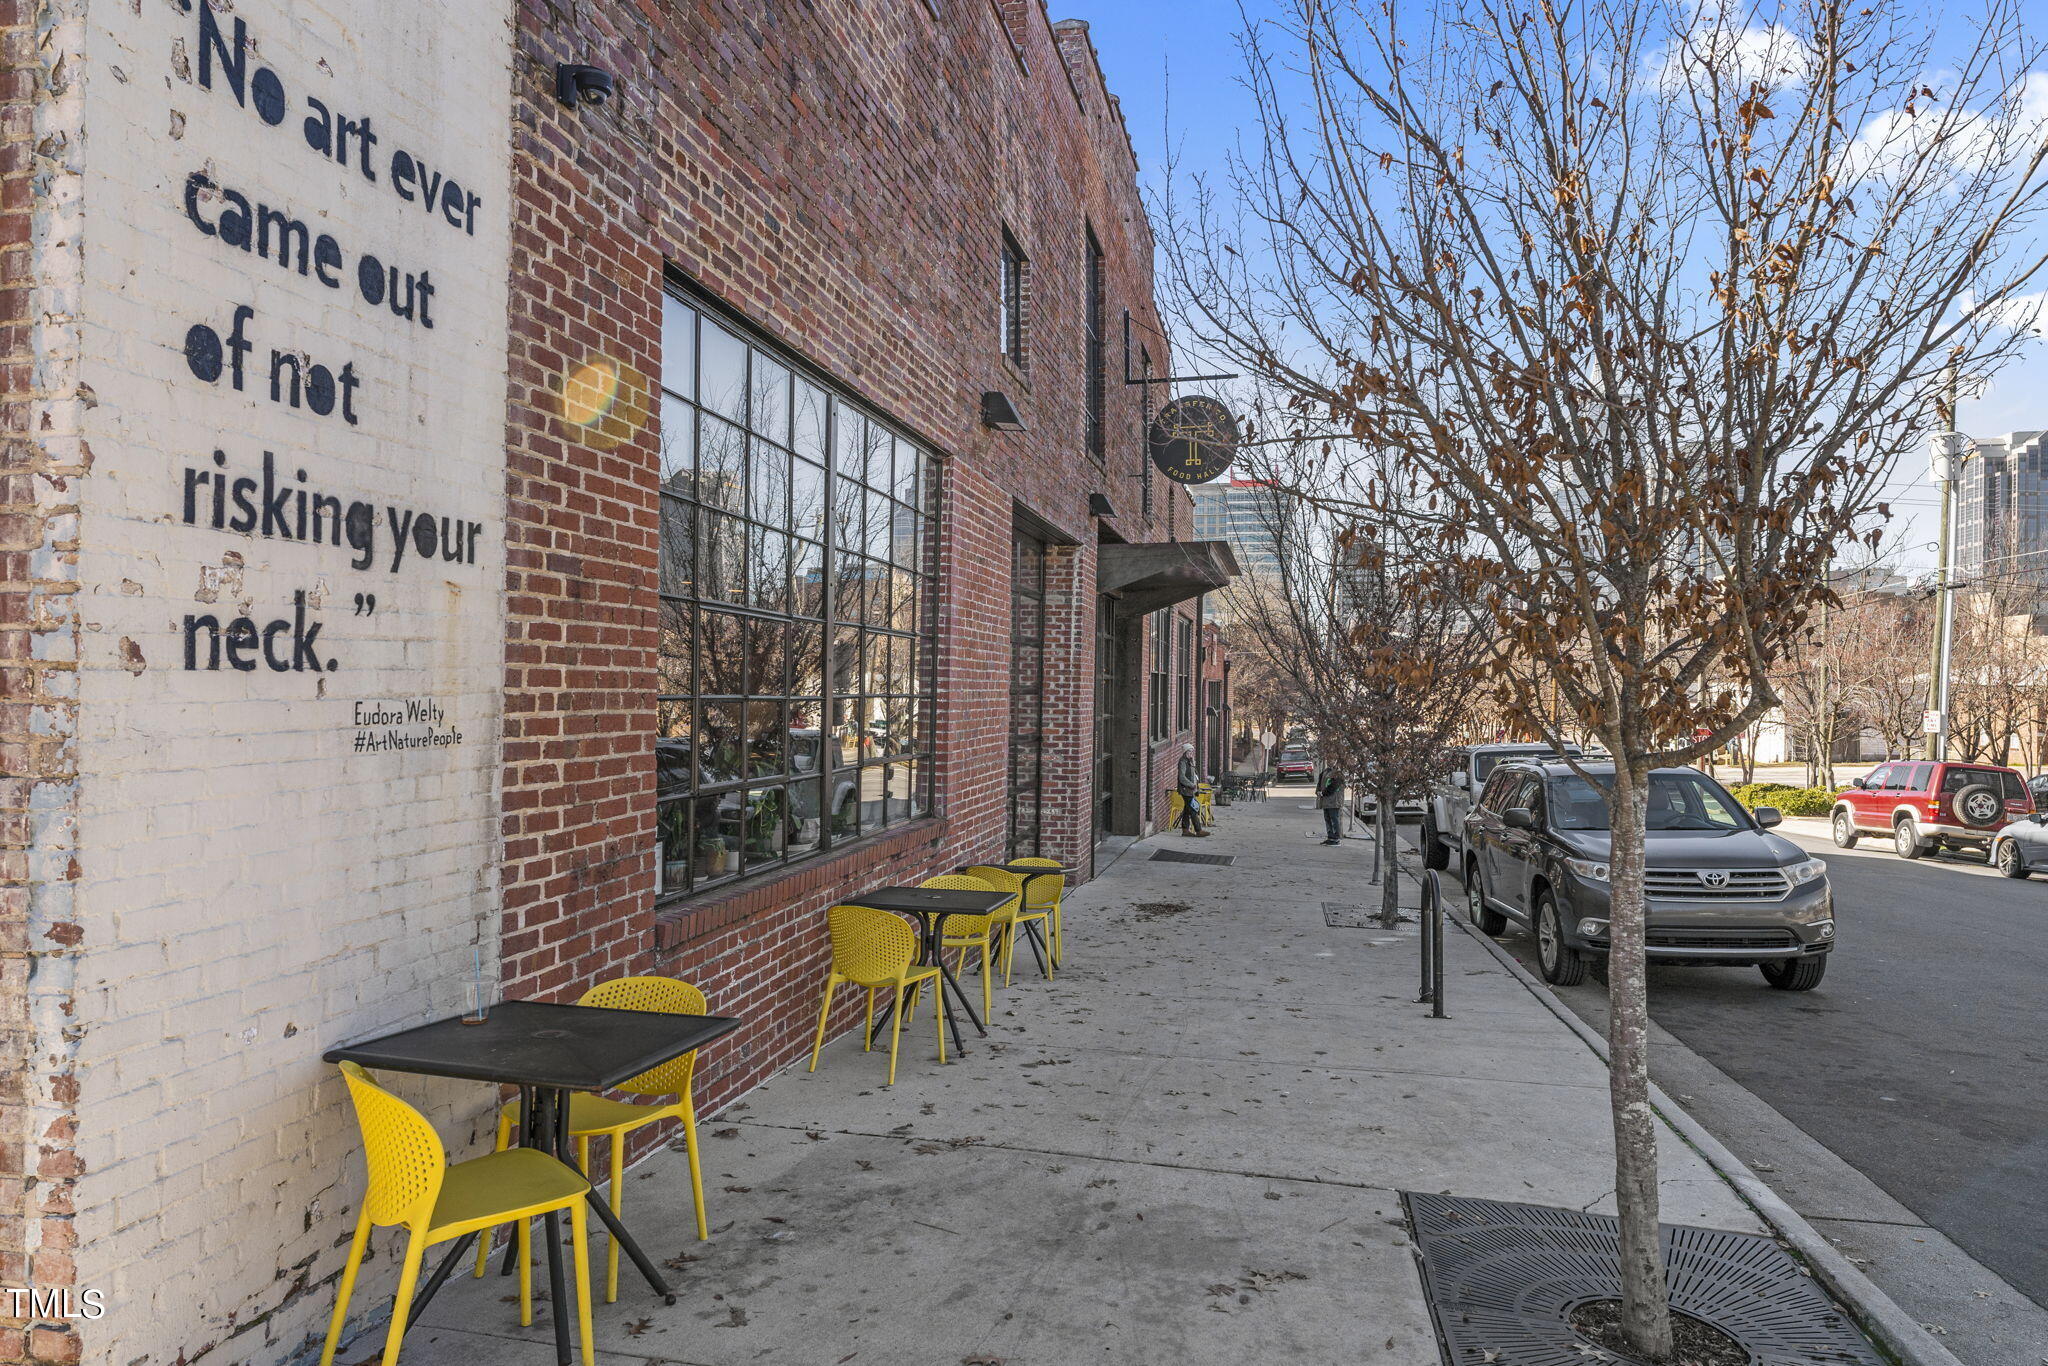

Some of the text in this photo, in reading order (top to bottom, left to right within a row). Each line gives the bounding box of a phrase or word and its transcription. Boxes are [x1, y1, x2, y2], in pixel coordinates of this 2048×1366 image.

[303, 95, 378, 183] art
[390, 149, 482, 236] ever
[184, 170, 435, 329] came out
[184, 305, 361, 426] of not
[1167, 465, 1221, 480] FOOD HALL
[182, 449, 482, 574] risking your
[354, 698, 445, 728] Eudora Welty
[354, 725, 463, 753] #ArtNaturePeople
[1691, 734, 1711, 744] STO
